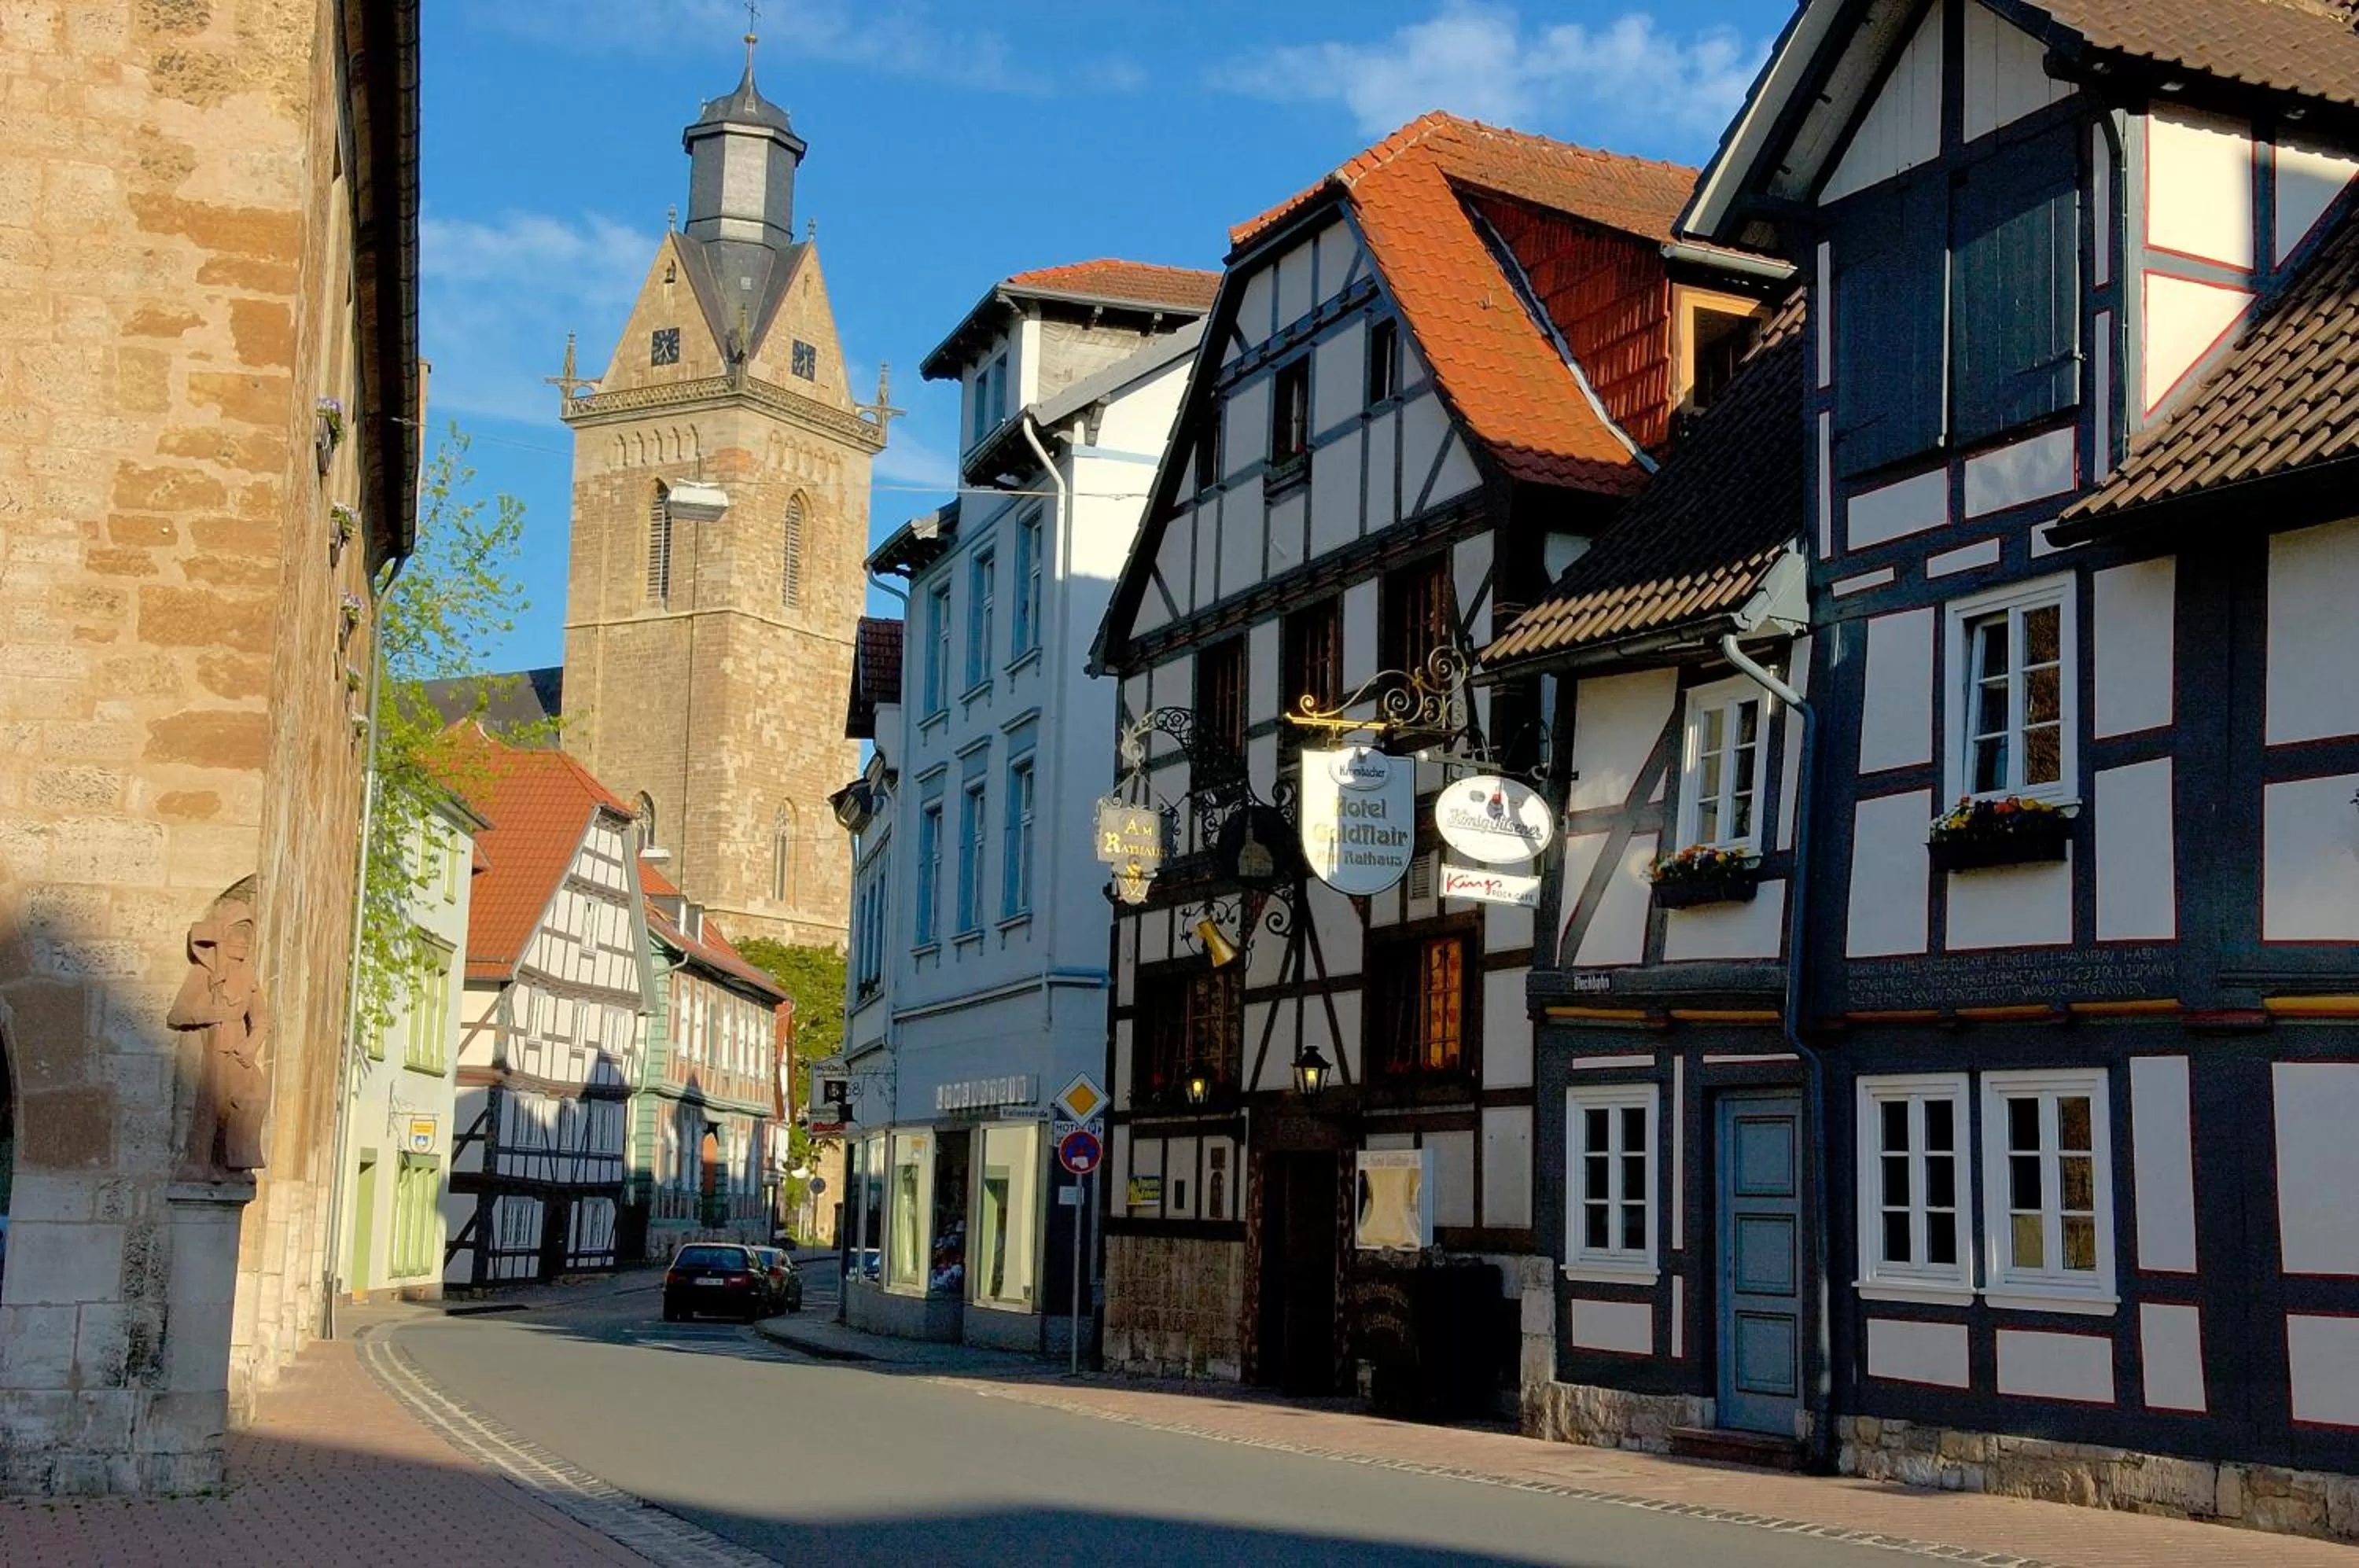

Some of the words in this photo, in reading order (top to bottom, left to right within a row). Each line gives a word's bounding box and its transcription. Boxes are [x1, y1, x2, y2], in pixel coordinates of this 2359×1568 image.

[1338, 764, 1386, 778] Krombacher
[1333, 796, 1387, 819] Hotel
[1314, 823, 1409, 848] Goldflair
[1343, 850, 1404, 867] Rathaus
[1446, 873, 1503, 896] Kings
